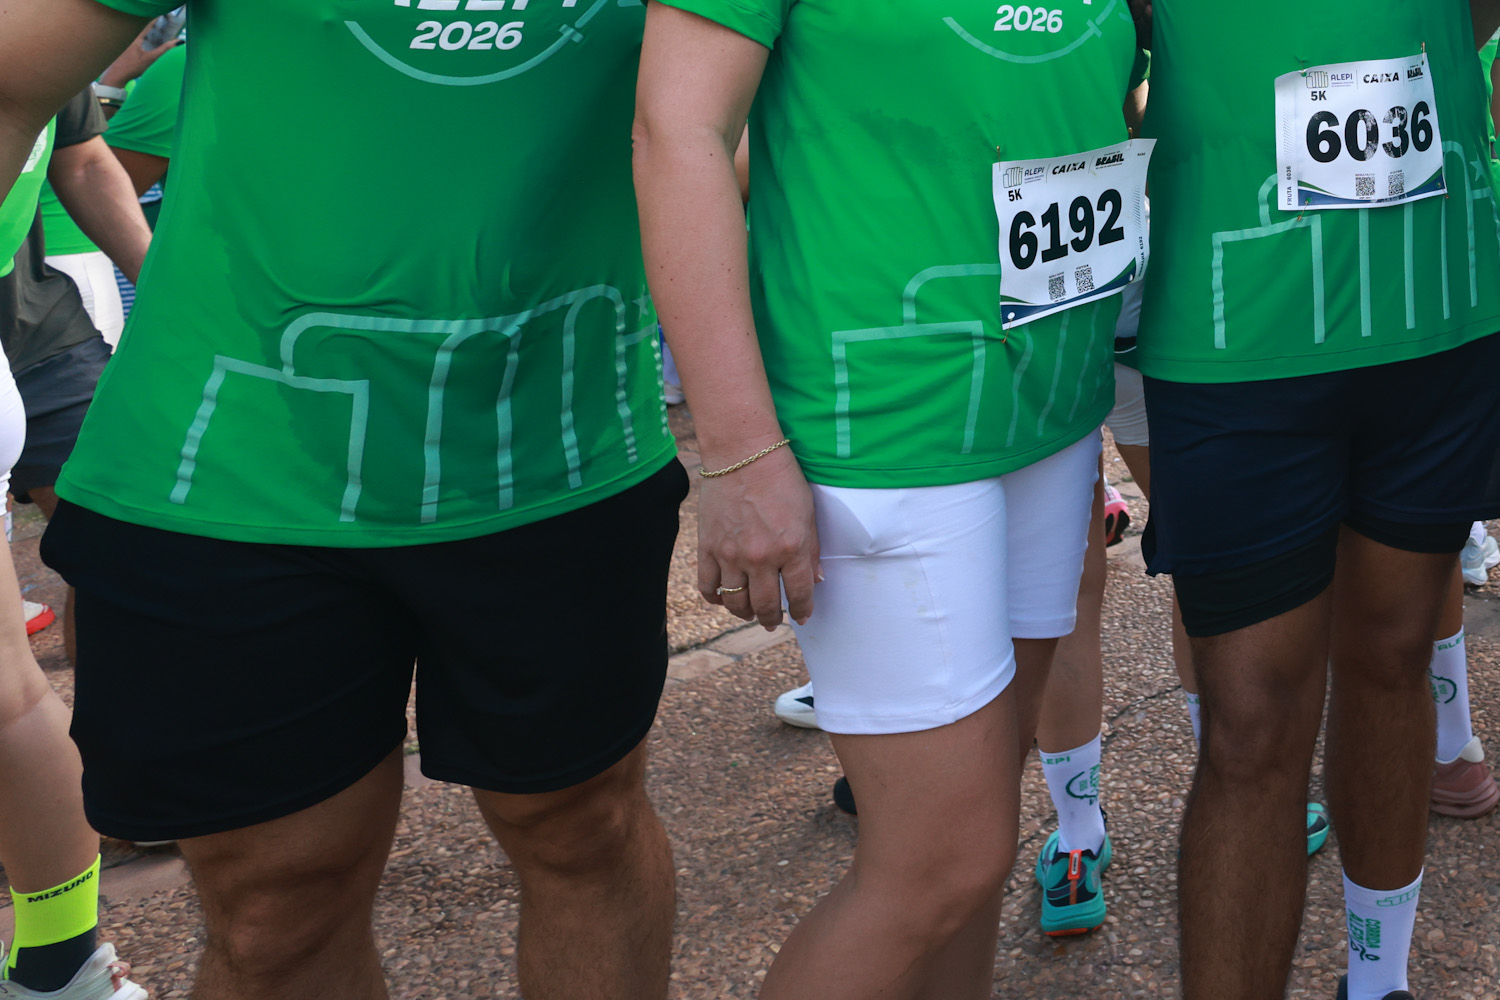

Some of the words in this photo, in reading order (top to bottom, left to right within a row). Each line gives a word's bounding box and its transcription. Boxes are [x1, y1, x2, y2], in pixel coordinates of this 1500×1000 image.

[993, 5, 1063, 33] 2026
[409, 21, 525, 50] 2026
[1331, 73, 1353, 81] ALEPI
[1363, 72, 1400, 84] CAIXA
[1311, 91, 1327, 101] 5K
[1306, 101, 1433, 163] 6036
[1095, 153, 1125, 167] BRASIL
[1024, 167, 1045, 177] ALEPI
[1052, 161, 1086, 175] CAIXA
[1008, 188, 1022, 202] 5K
[1009, 188, 1124, 270] 6192
[27, 871, 93, 902] MIZUNO
